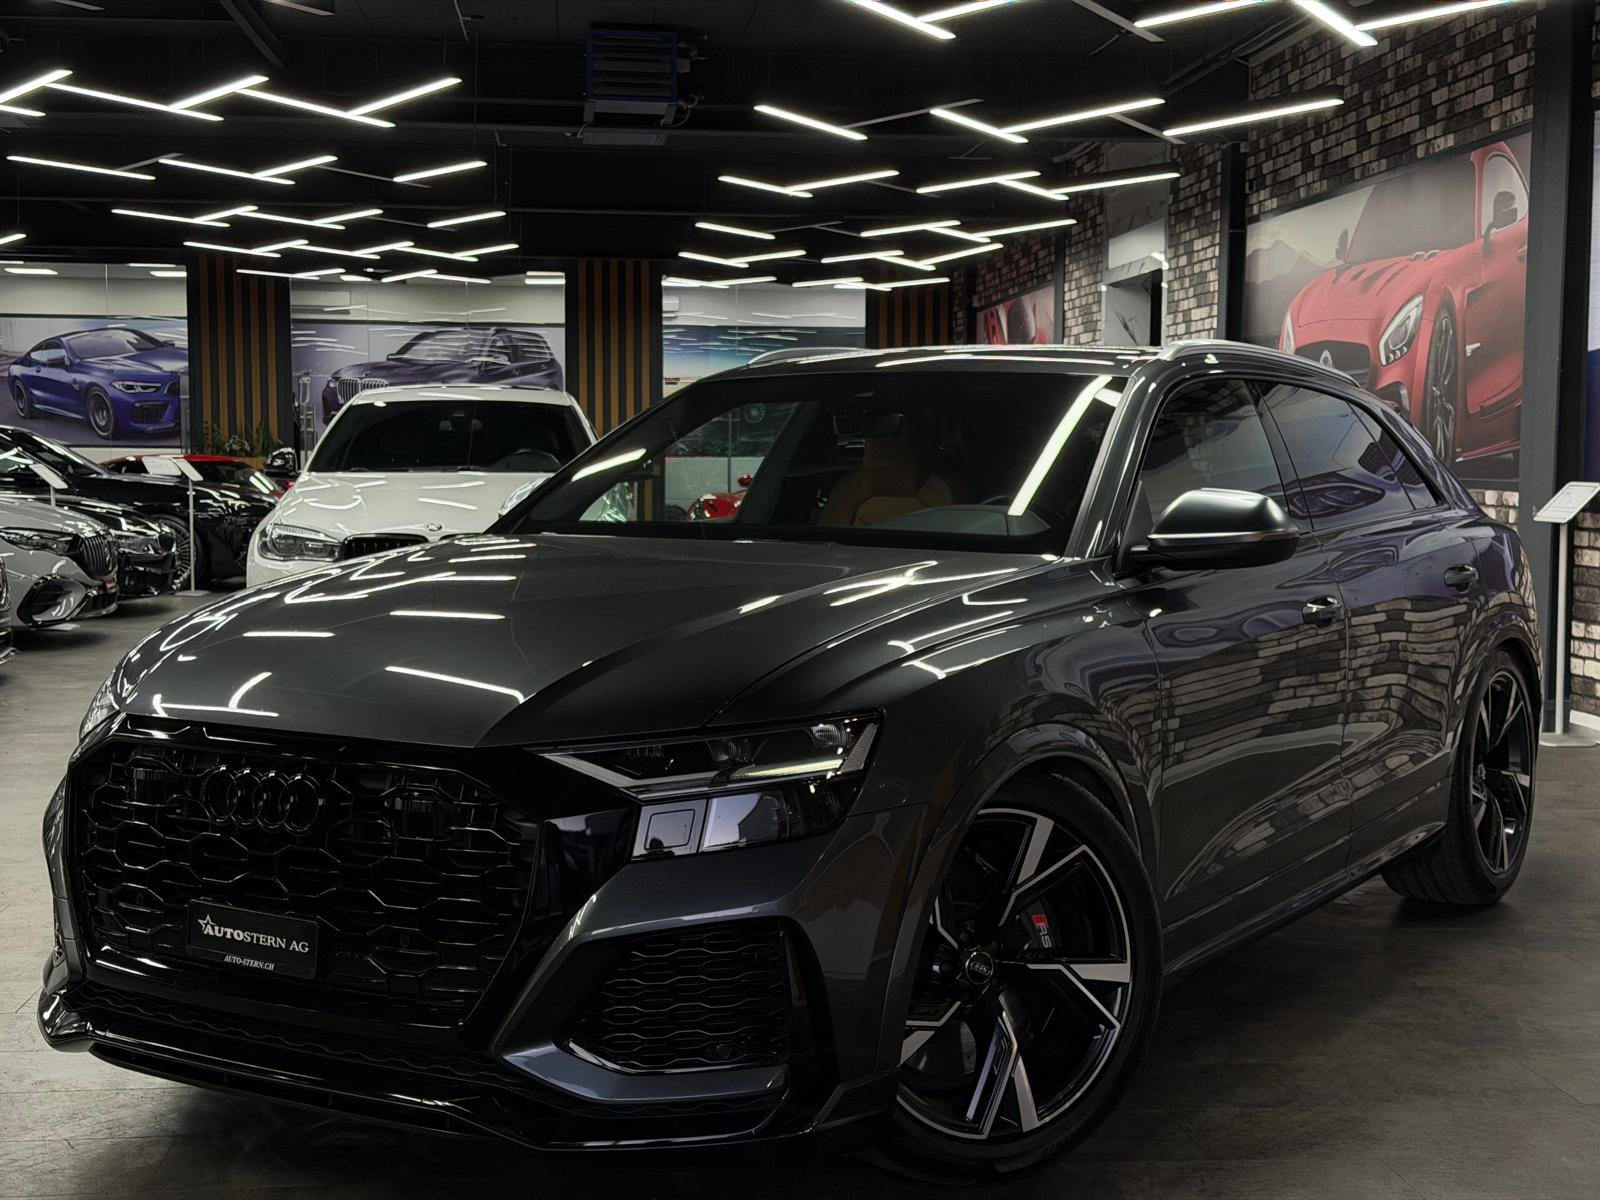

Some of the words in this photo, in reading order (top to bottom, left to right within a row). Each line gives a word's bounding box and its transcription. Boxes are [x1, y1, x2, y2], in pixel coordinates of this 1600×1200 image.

[203, 925, 287, 949] AUTOSTERN
[289, 939, 310, 953] AG
[1039, 923, 1052, 949] RS
[223, 954, 275, 971] AUTO-STERN.CH
